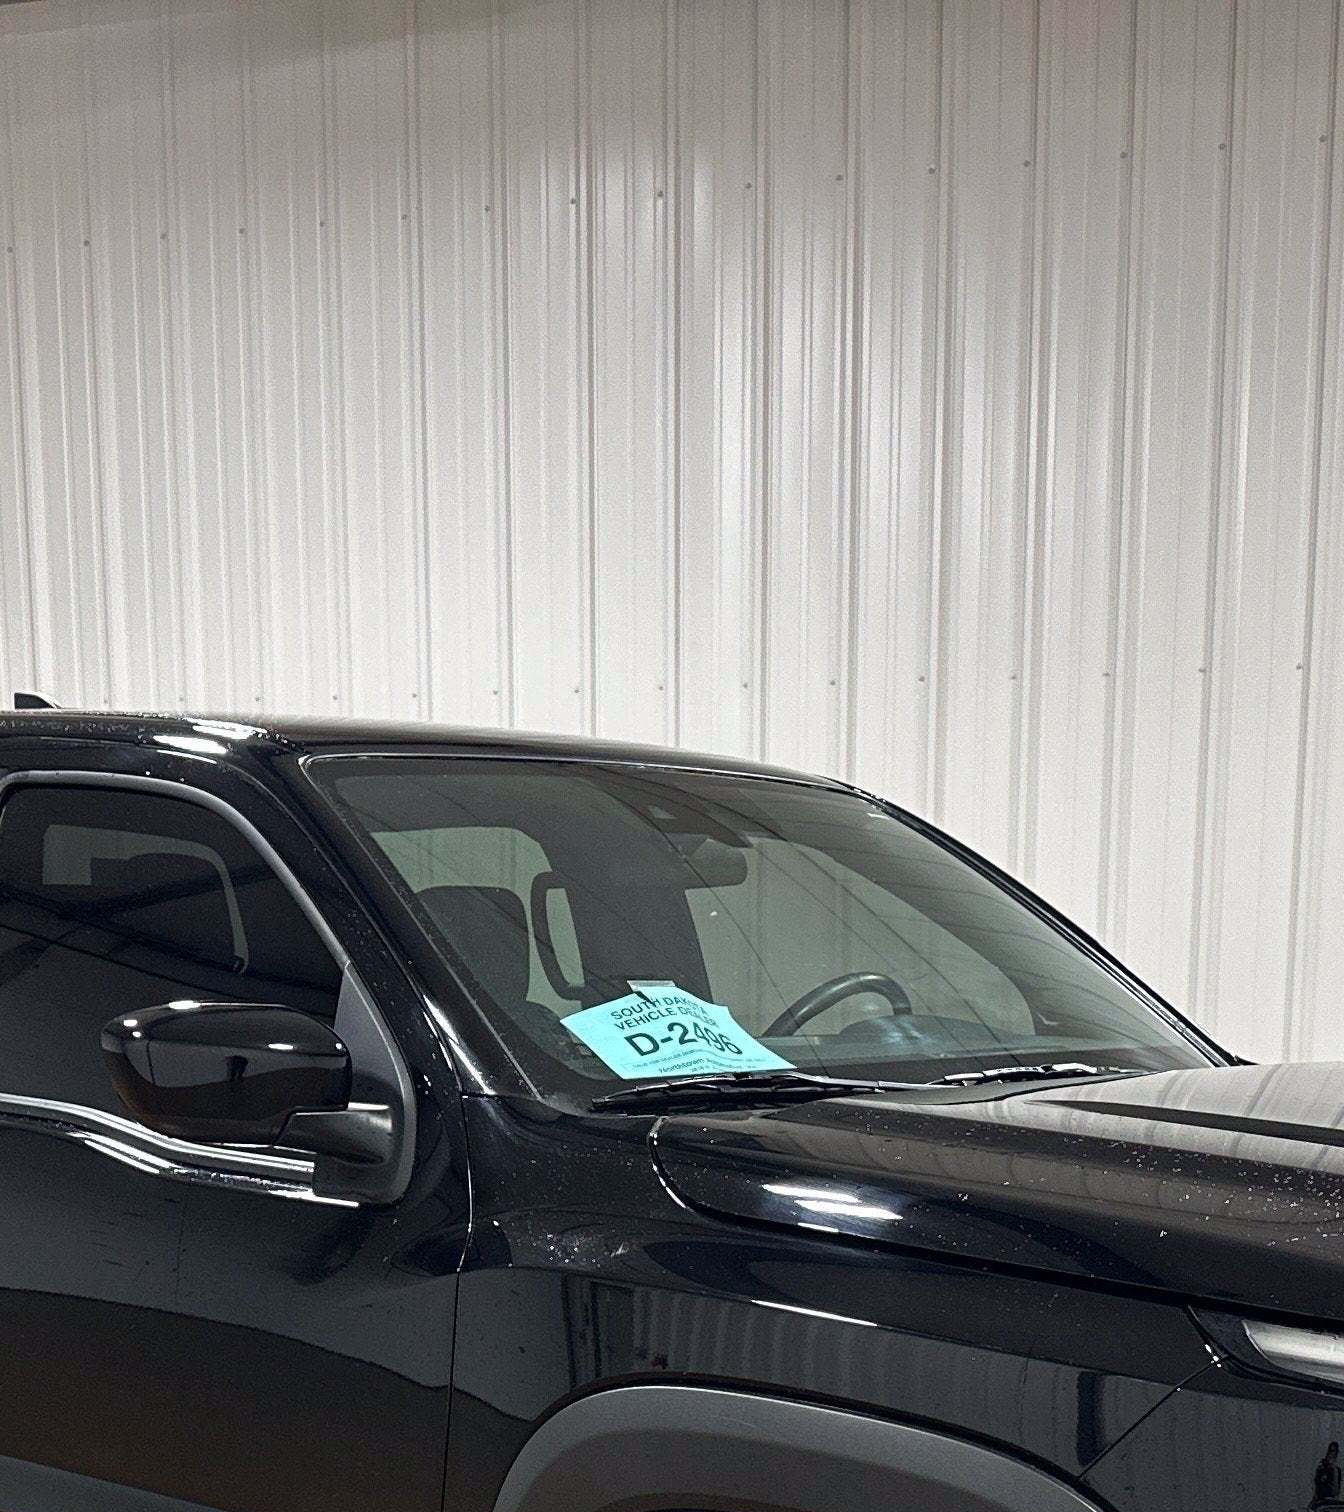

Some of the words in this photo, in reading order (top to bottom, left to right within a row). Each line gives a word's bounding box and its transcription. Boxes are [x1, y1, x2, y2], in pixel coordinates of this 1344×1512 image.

[611, 997, 661, 1020] SOUTH
[662, 994, 709, 1016] DAKOTA
[614, 1006, 677, 1031] VEHICLE
[676, 1005, 720, 1029] DEALER
[624, 1022, 743, 1057] D-2496
